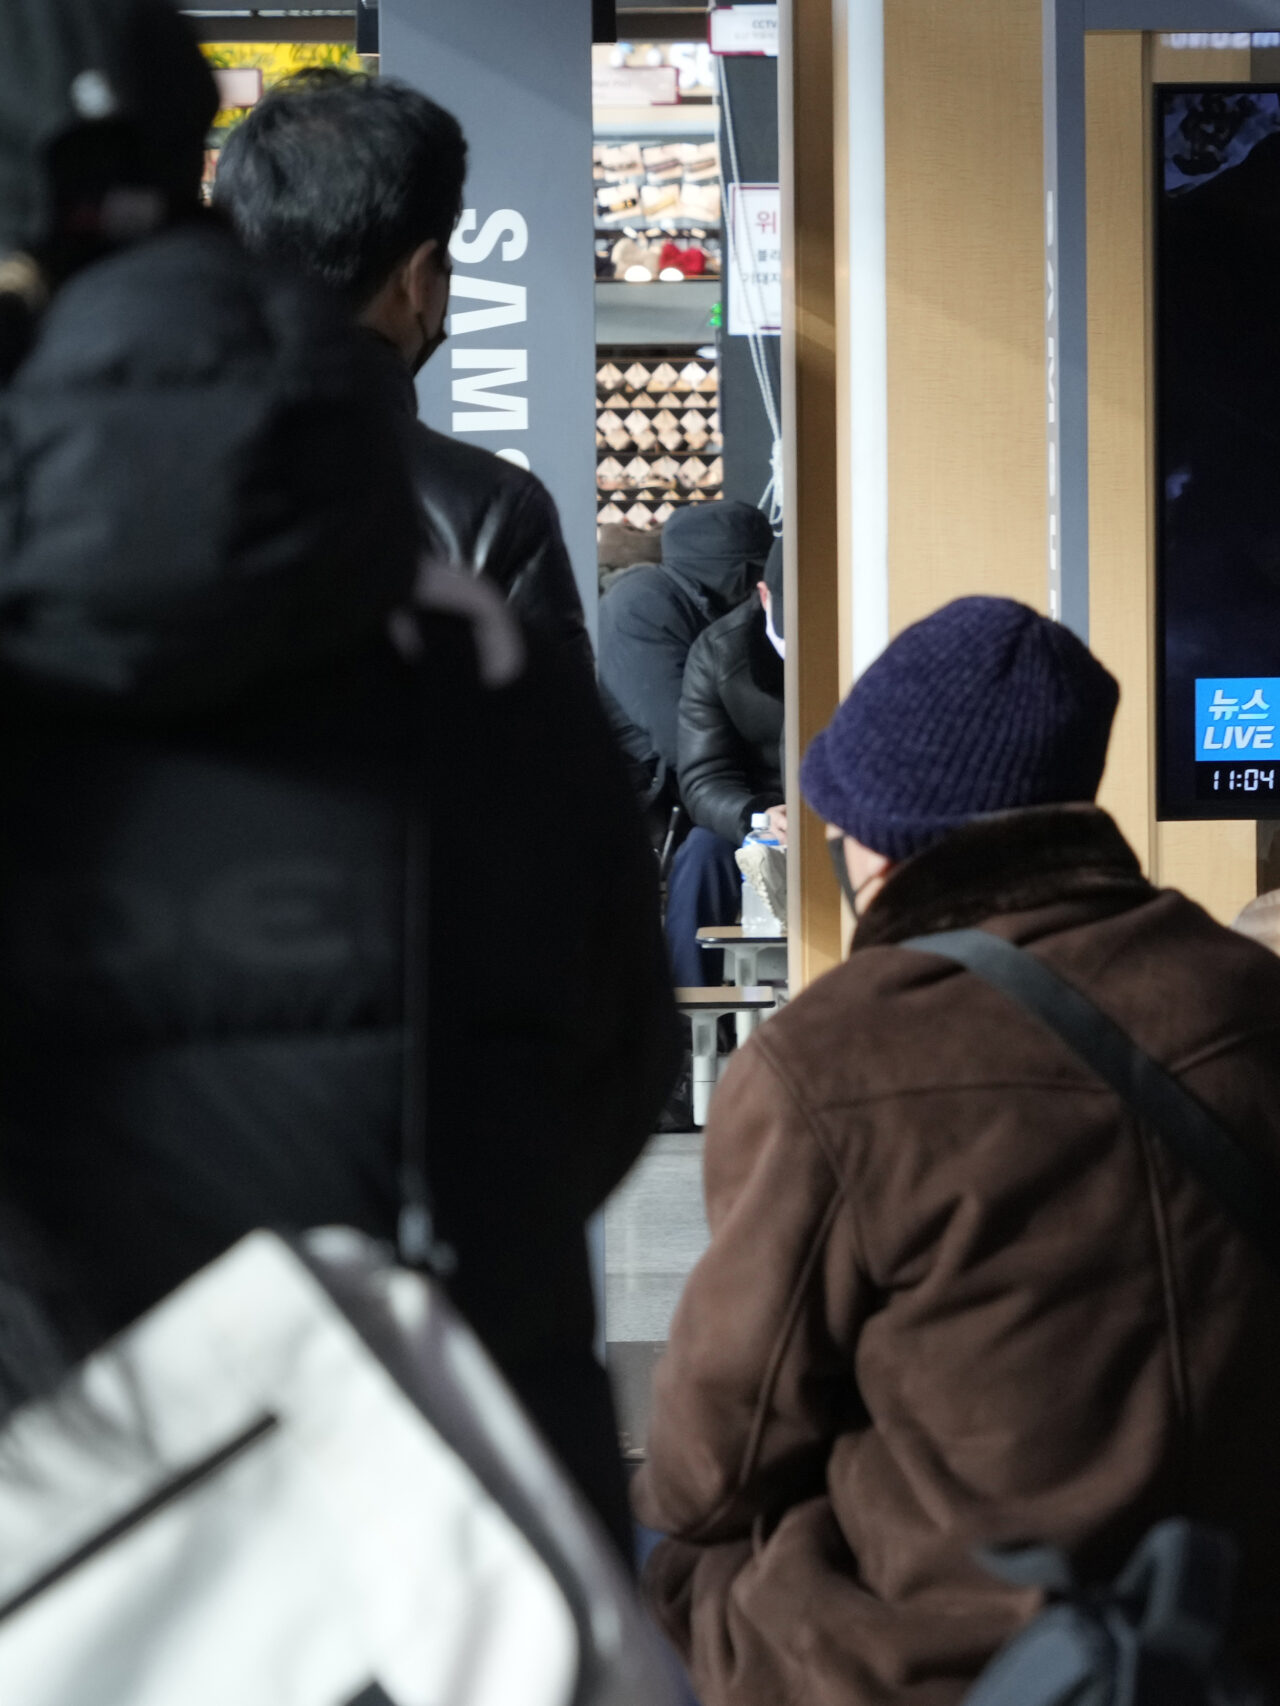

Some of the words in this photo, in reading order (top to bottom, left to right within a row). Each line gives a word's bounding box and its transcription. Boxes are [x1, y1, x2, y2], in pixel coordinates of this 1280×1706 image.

[448, 208, 530, 470] SAM
[1208, 689, 1271, 721] 뉴스
[1203, 726, 1276, 750] LIVE
[1213, 768, 1275, 791] 11:04
